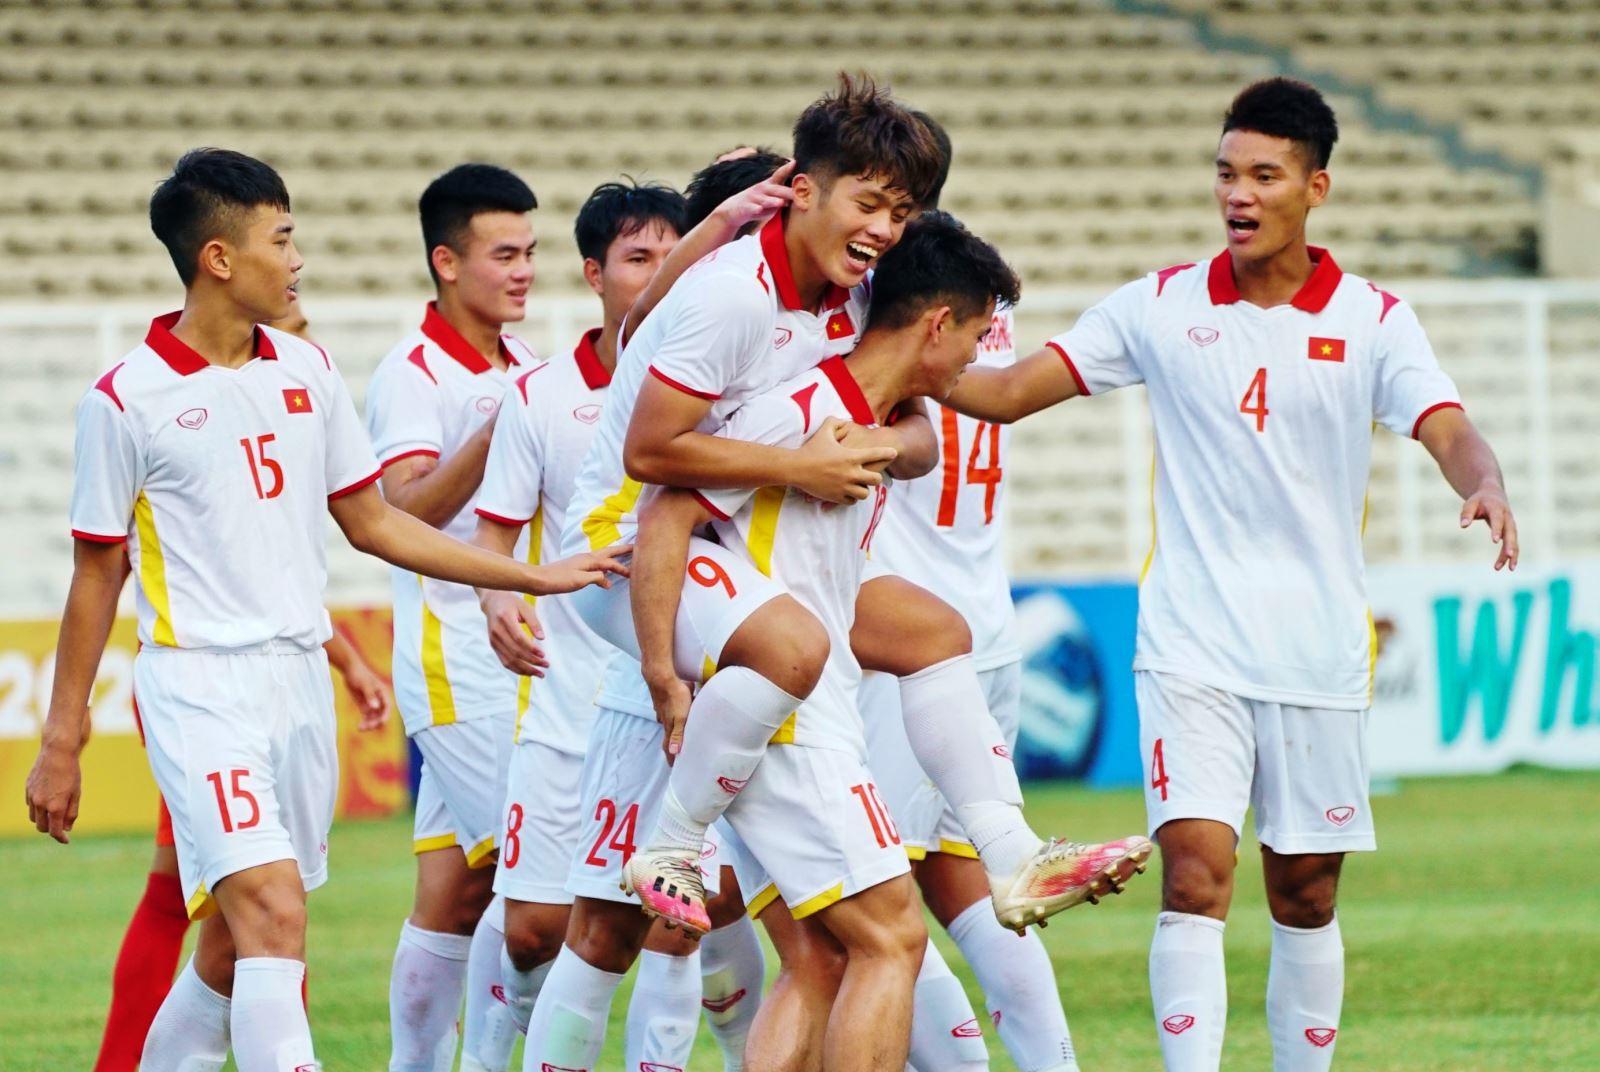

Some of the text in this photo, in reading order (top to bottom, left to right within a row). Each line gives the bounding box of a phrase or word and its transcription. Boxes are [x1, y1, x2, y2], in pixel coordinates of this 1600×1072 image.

[1240, 368, 1269, 432] 4
[240, 434, 284, 499] 15
[936, 405, 1002, 527] 14
[687, 556, 737, 599] 9
[206, 770, 260, 833] 15
[1151, 738, 1169, 801] 4
[504, 803, 523, 869] 8
[585, 799, 639, 868] 24
